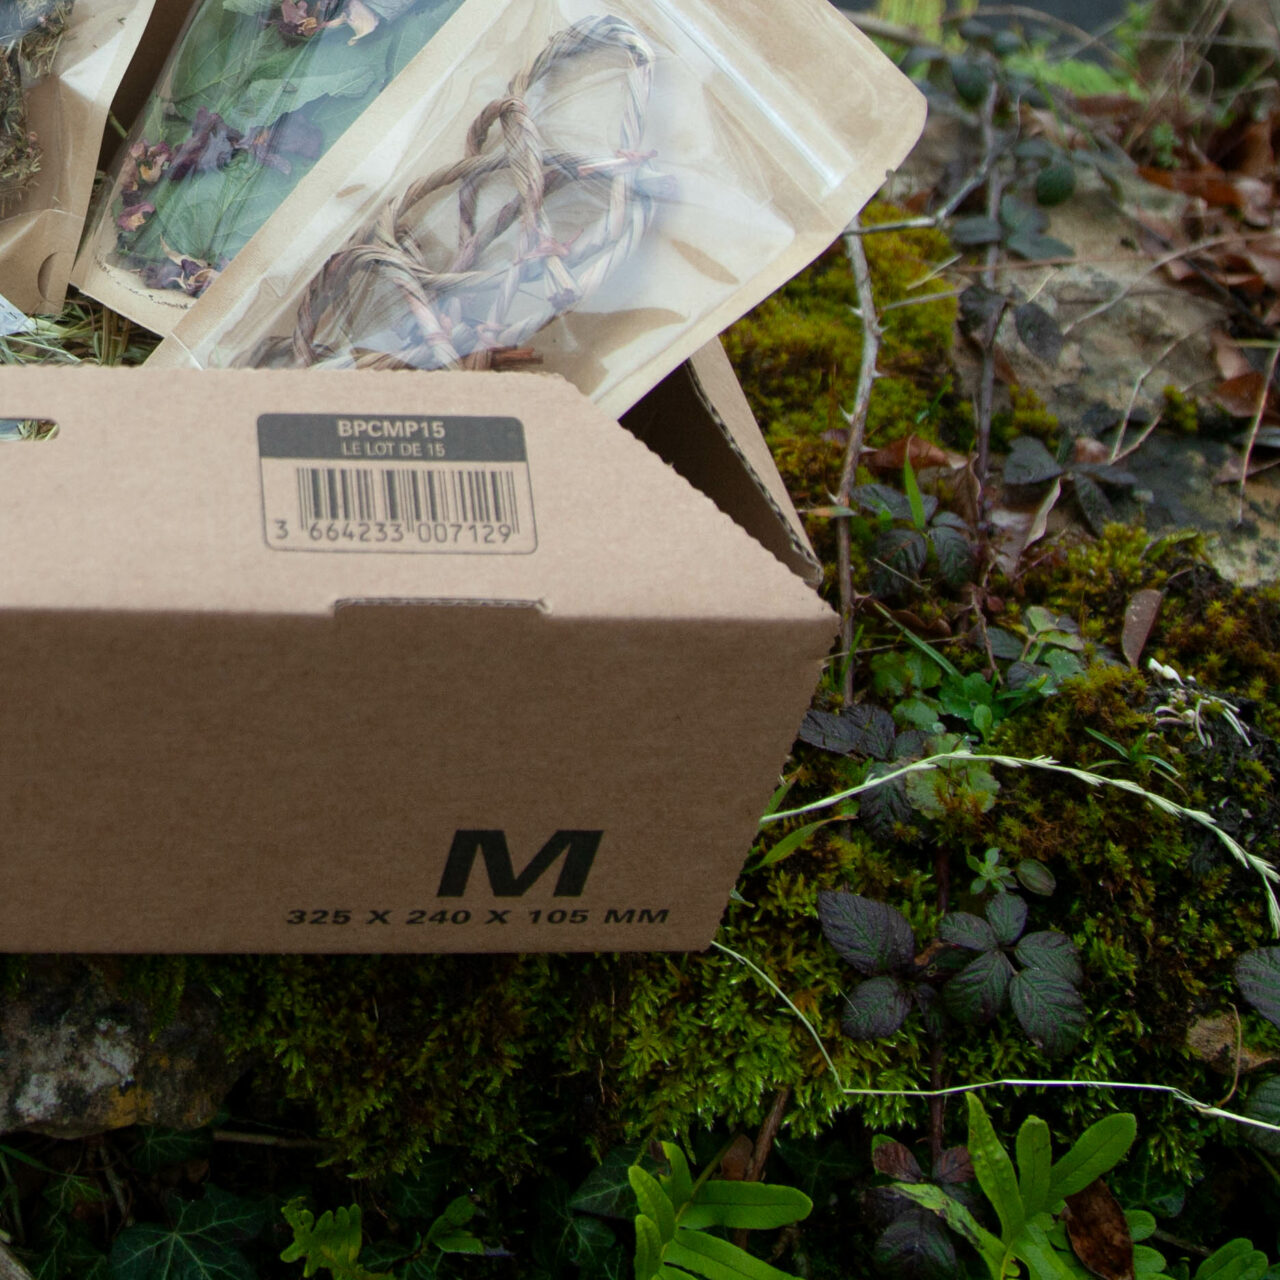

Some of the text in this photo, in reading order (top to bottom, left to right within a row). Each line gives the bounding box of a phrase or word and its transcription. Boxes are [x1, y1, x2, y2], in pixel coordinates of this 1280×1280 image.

[337, 419, 446, 439] BPCMP15
[342, 441, 446, 458] LE LOT DE 15
[275, 520, 512, 545] 3 664233 007129
[437, 829, 605, 898] M
[286, 909, 353, 925] 325
[405, 909, 472, 925] 240
[528, 909, 589, 924] 105
[604, 908, 671, 924] MM
